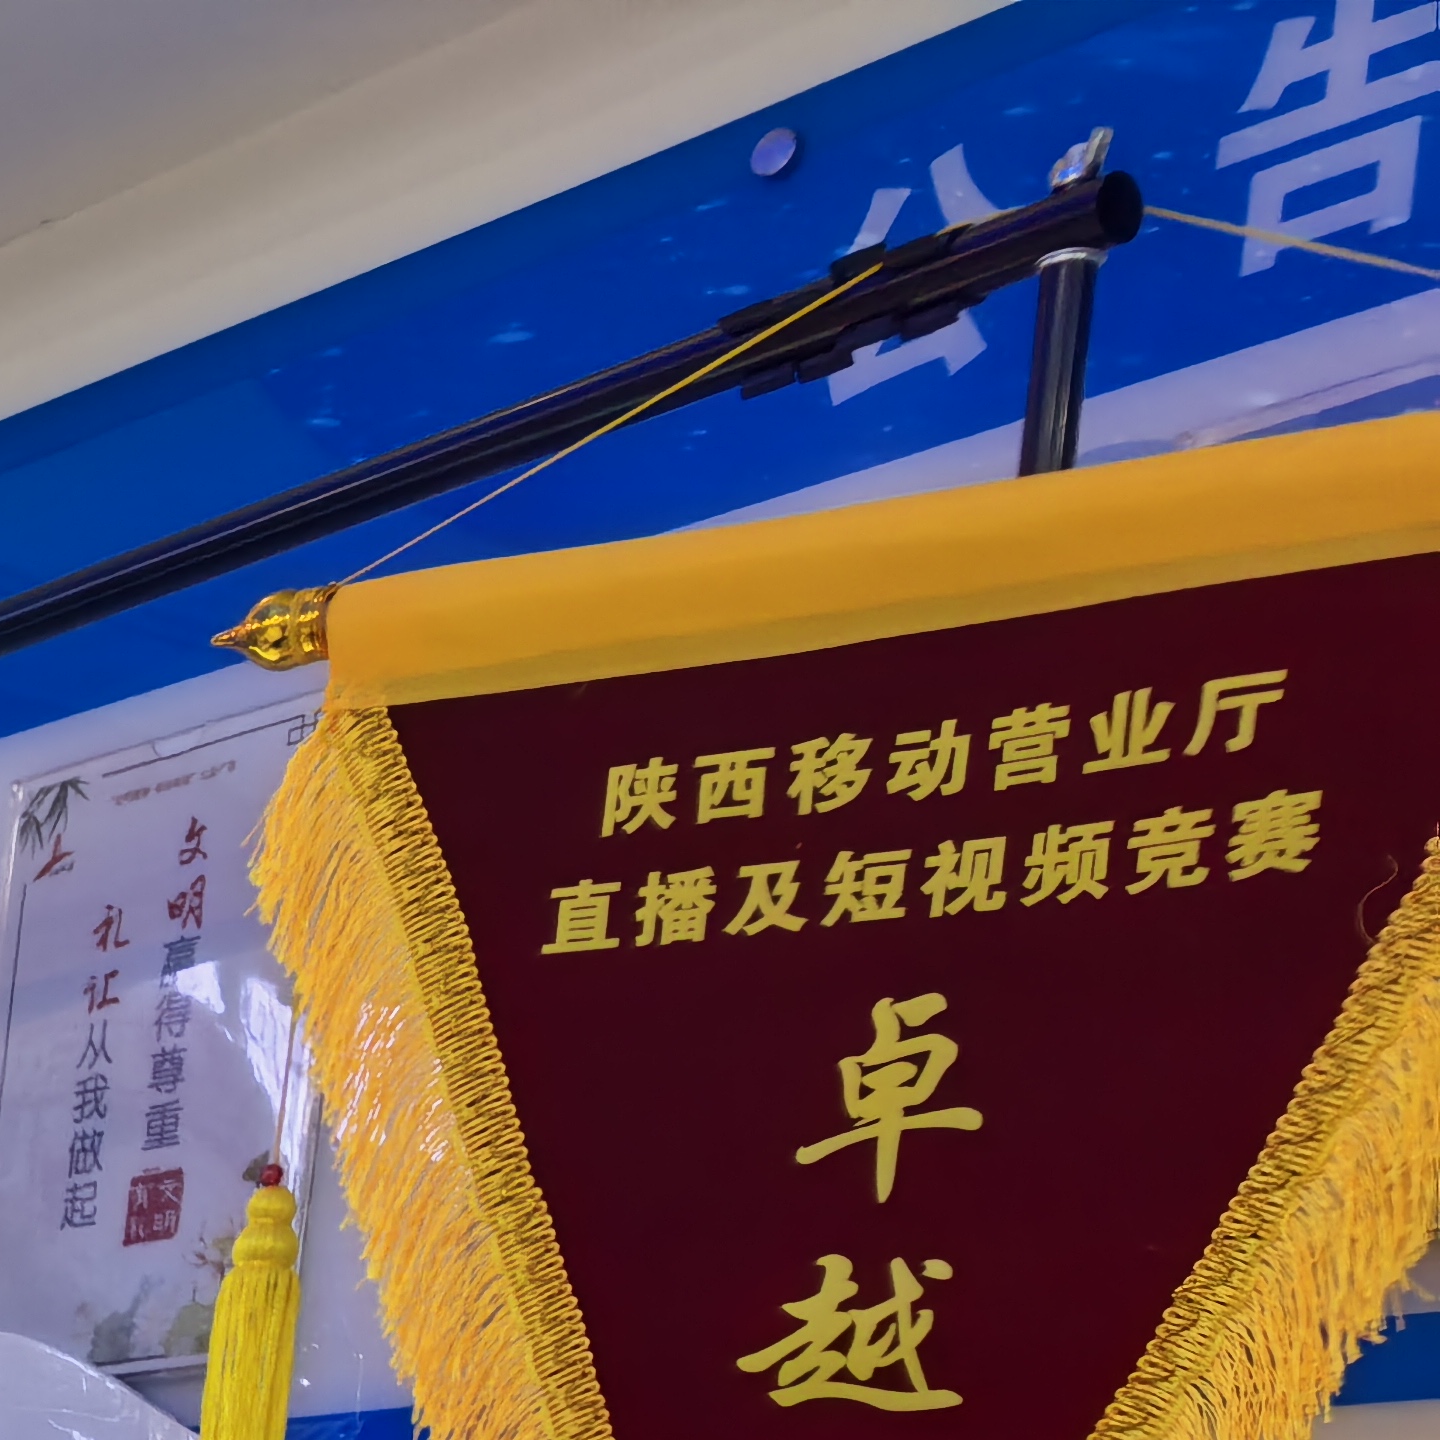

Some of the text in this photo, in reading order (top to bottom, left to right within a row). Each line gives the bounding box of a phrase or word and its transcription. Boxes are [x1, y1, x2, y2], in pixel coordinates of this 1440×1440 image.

[600, 669, 1288, 838] 陕西移动营业厅
[541, 789, 1323, 956] 直播及短视频竞赛
